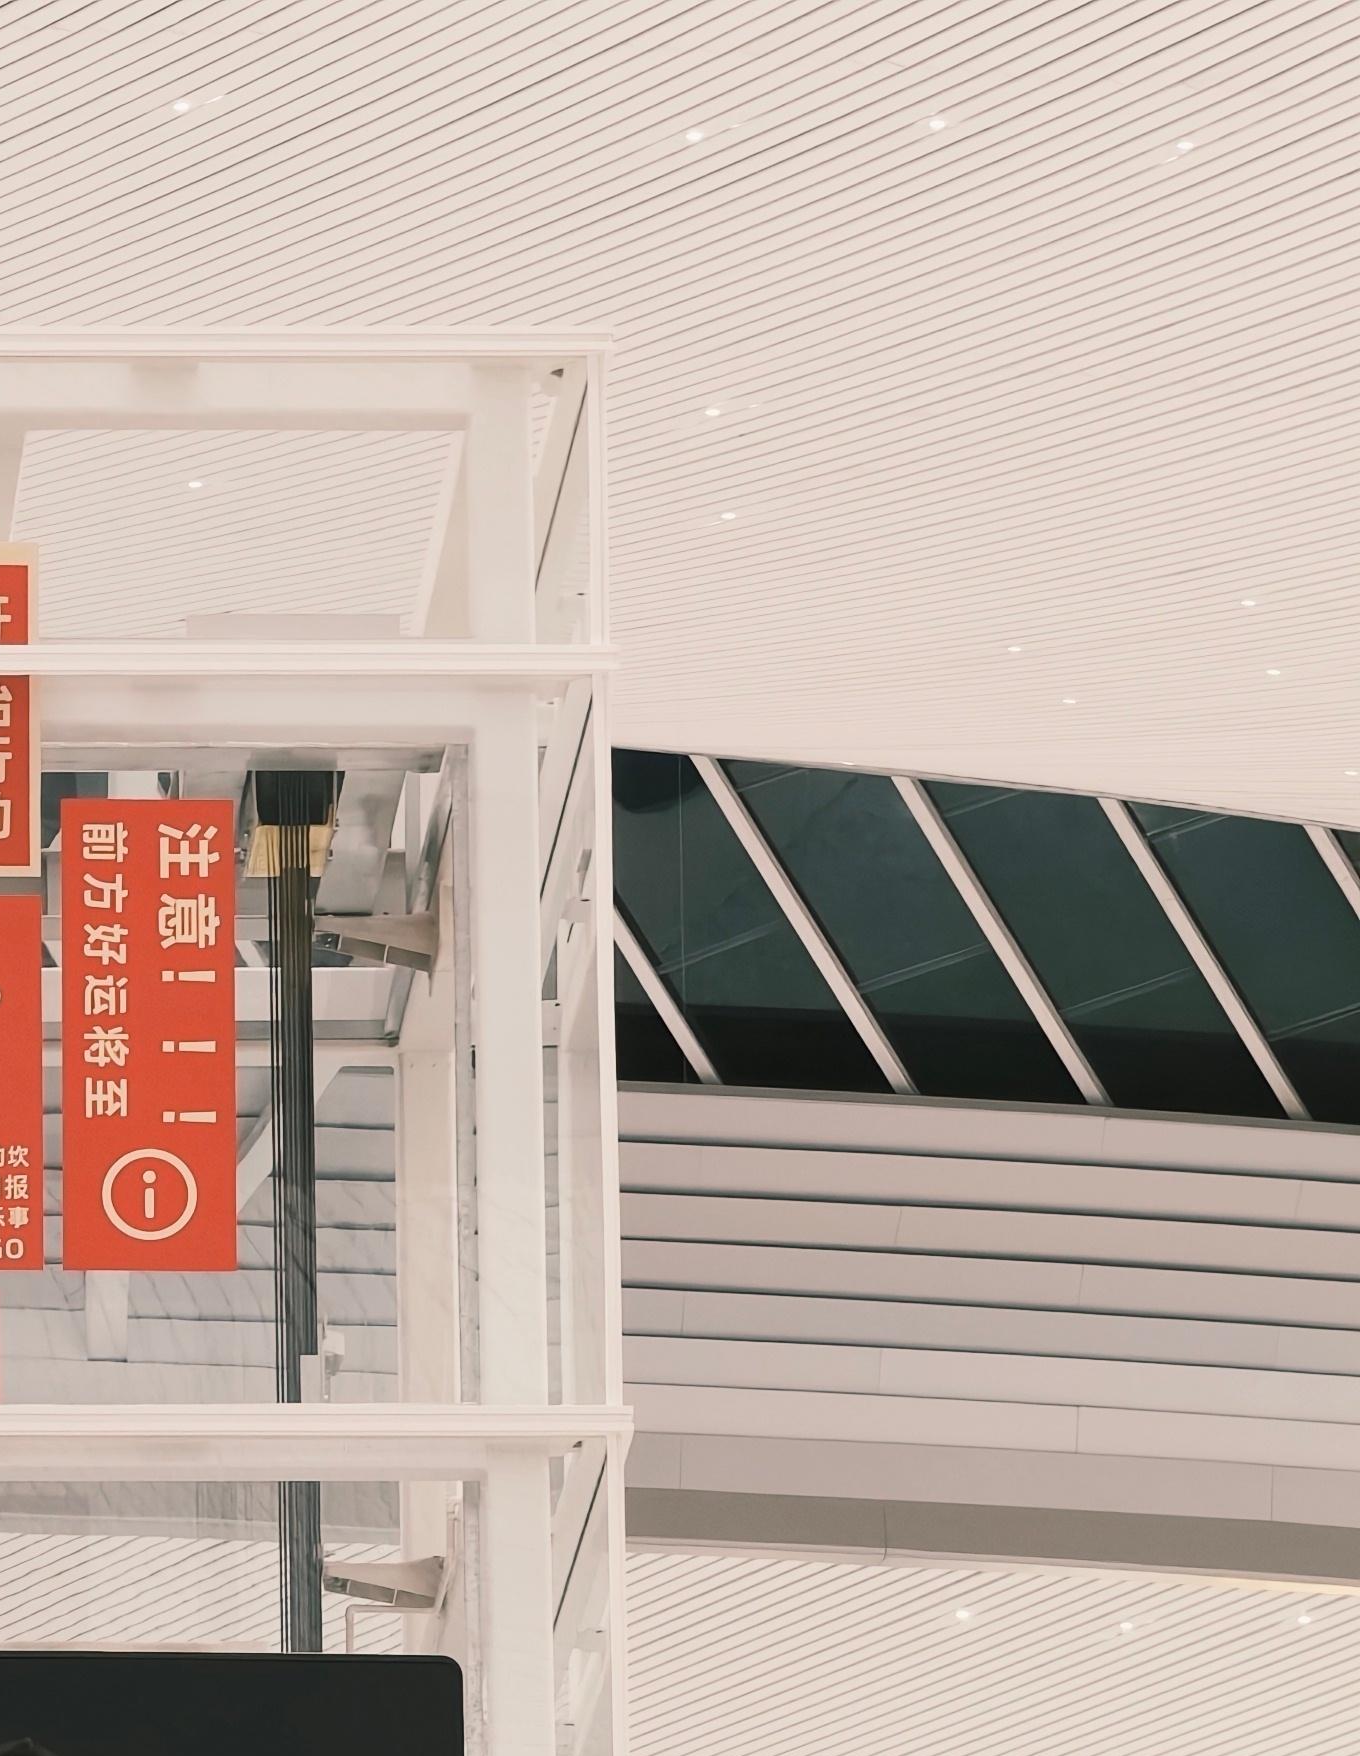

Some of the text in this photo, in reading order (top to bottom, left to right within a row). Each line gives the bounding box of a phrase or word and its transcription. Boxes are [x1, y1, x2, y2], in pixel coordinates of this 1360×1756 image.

[83, 822, 129, 1118] 前方好运将至
